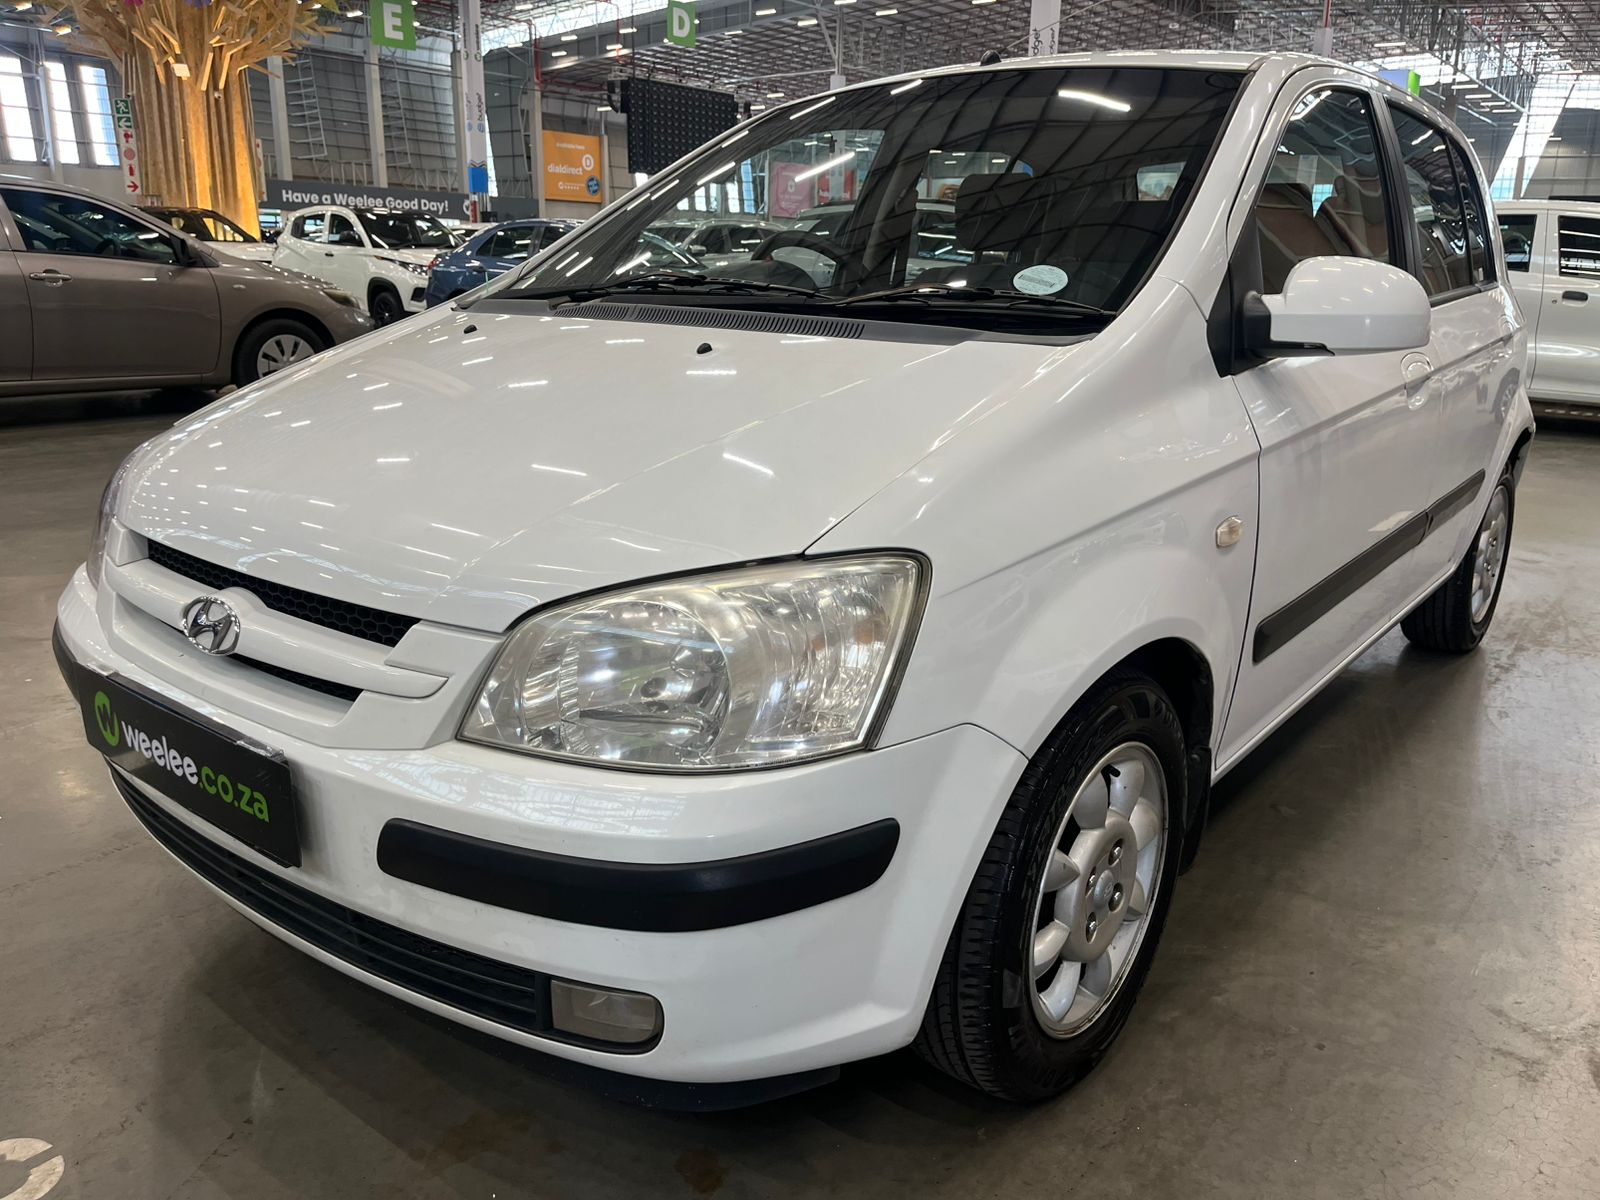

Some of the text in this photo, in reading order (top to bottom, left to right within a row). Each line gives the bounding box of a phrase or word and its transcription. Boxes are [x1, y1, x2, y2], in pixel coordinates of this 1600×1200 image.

[383, 2, 404, 40] E
[672, 6, 690, 38] D
[1031, 26, 1043, 57] dget
[547, 163, 583, 176] dialdirect
[282, 189, 449, 216] Have a Weelee Good Day!
[121, 720, 270, 823] weelee.co.za
